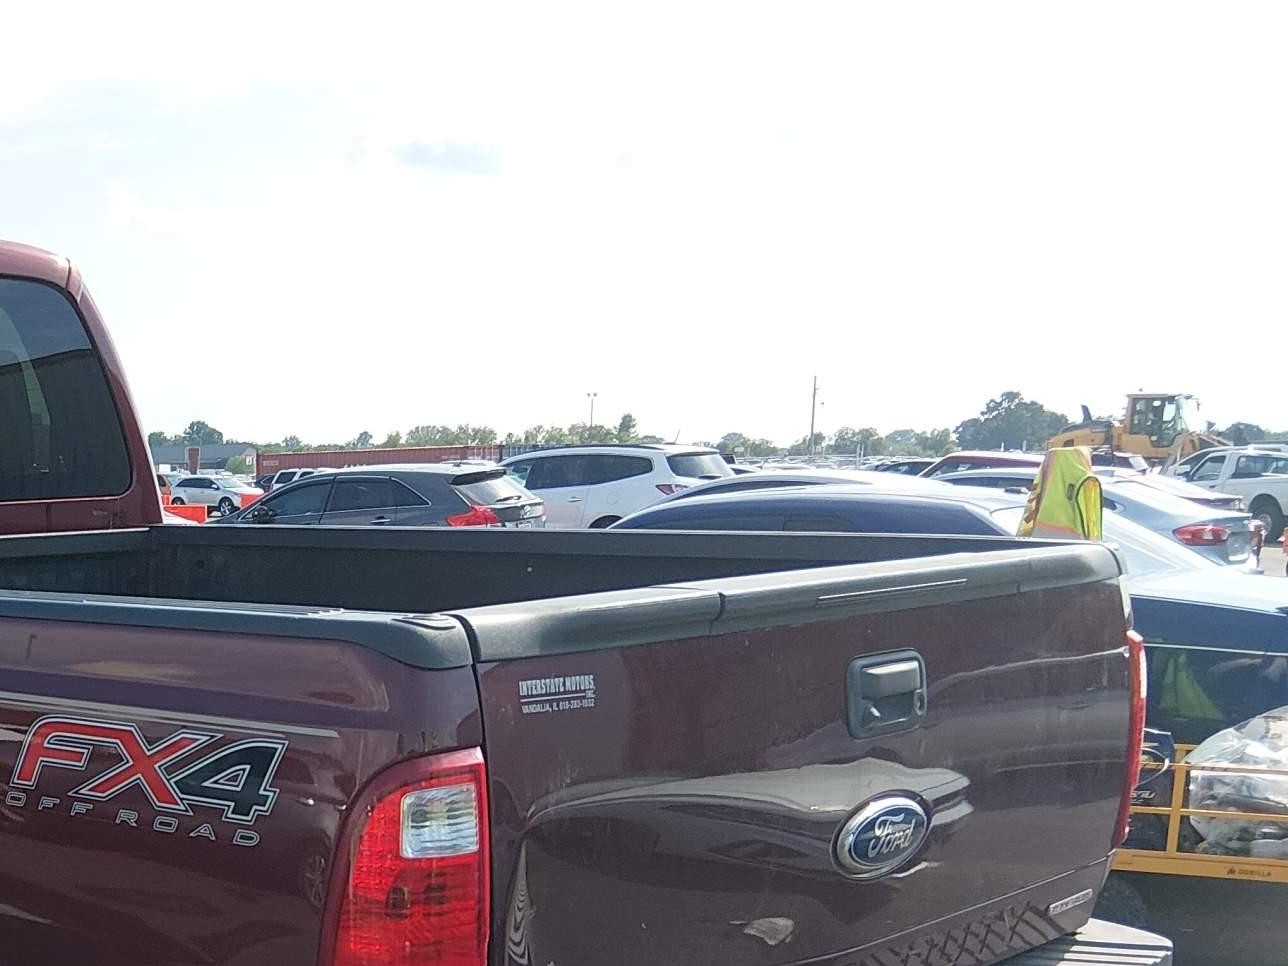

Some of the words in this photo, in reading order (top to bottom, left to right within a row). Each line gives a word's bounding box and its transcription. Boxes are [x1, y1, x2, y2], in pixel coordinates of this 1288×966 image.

[519, 678, 564, 695] INTERSTATE
[522, 703, 552, 714] VANDALIA,
[8, 714, 289, 826] FX4
[5, 791, 93, 816] OFF
[115, 810, 261, 847] ROAD
[868, 813, 915, 858] Ford
